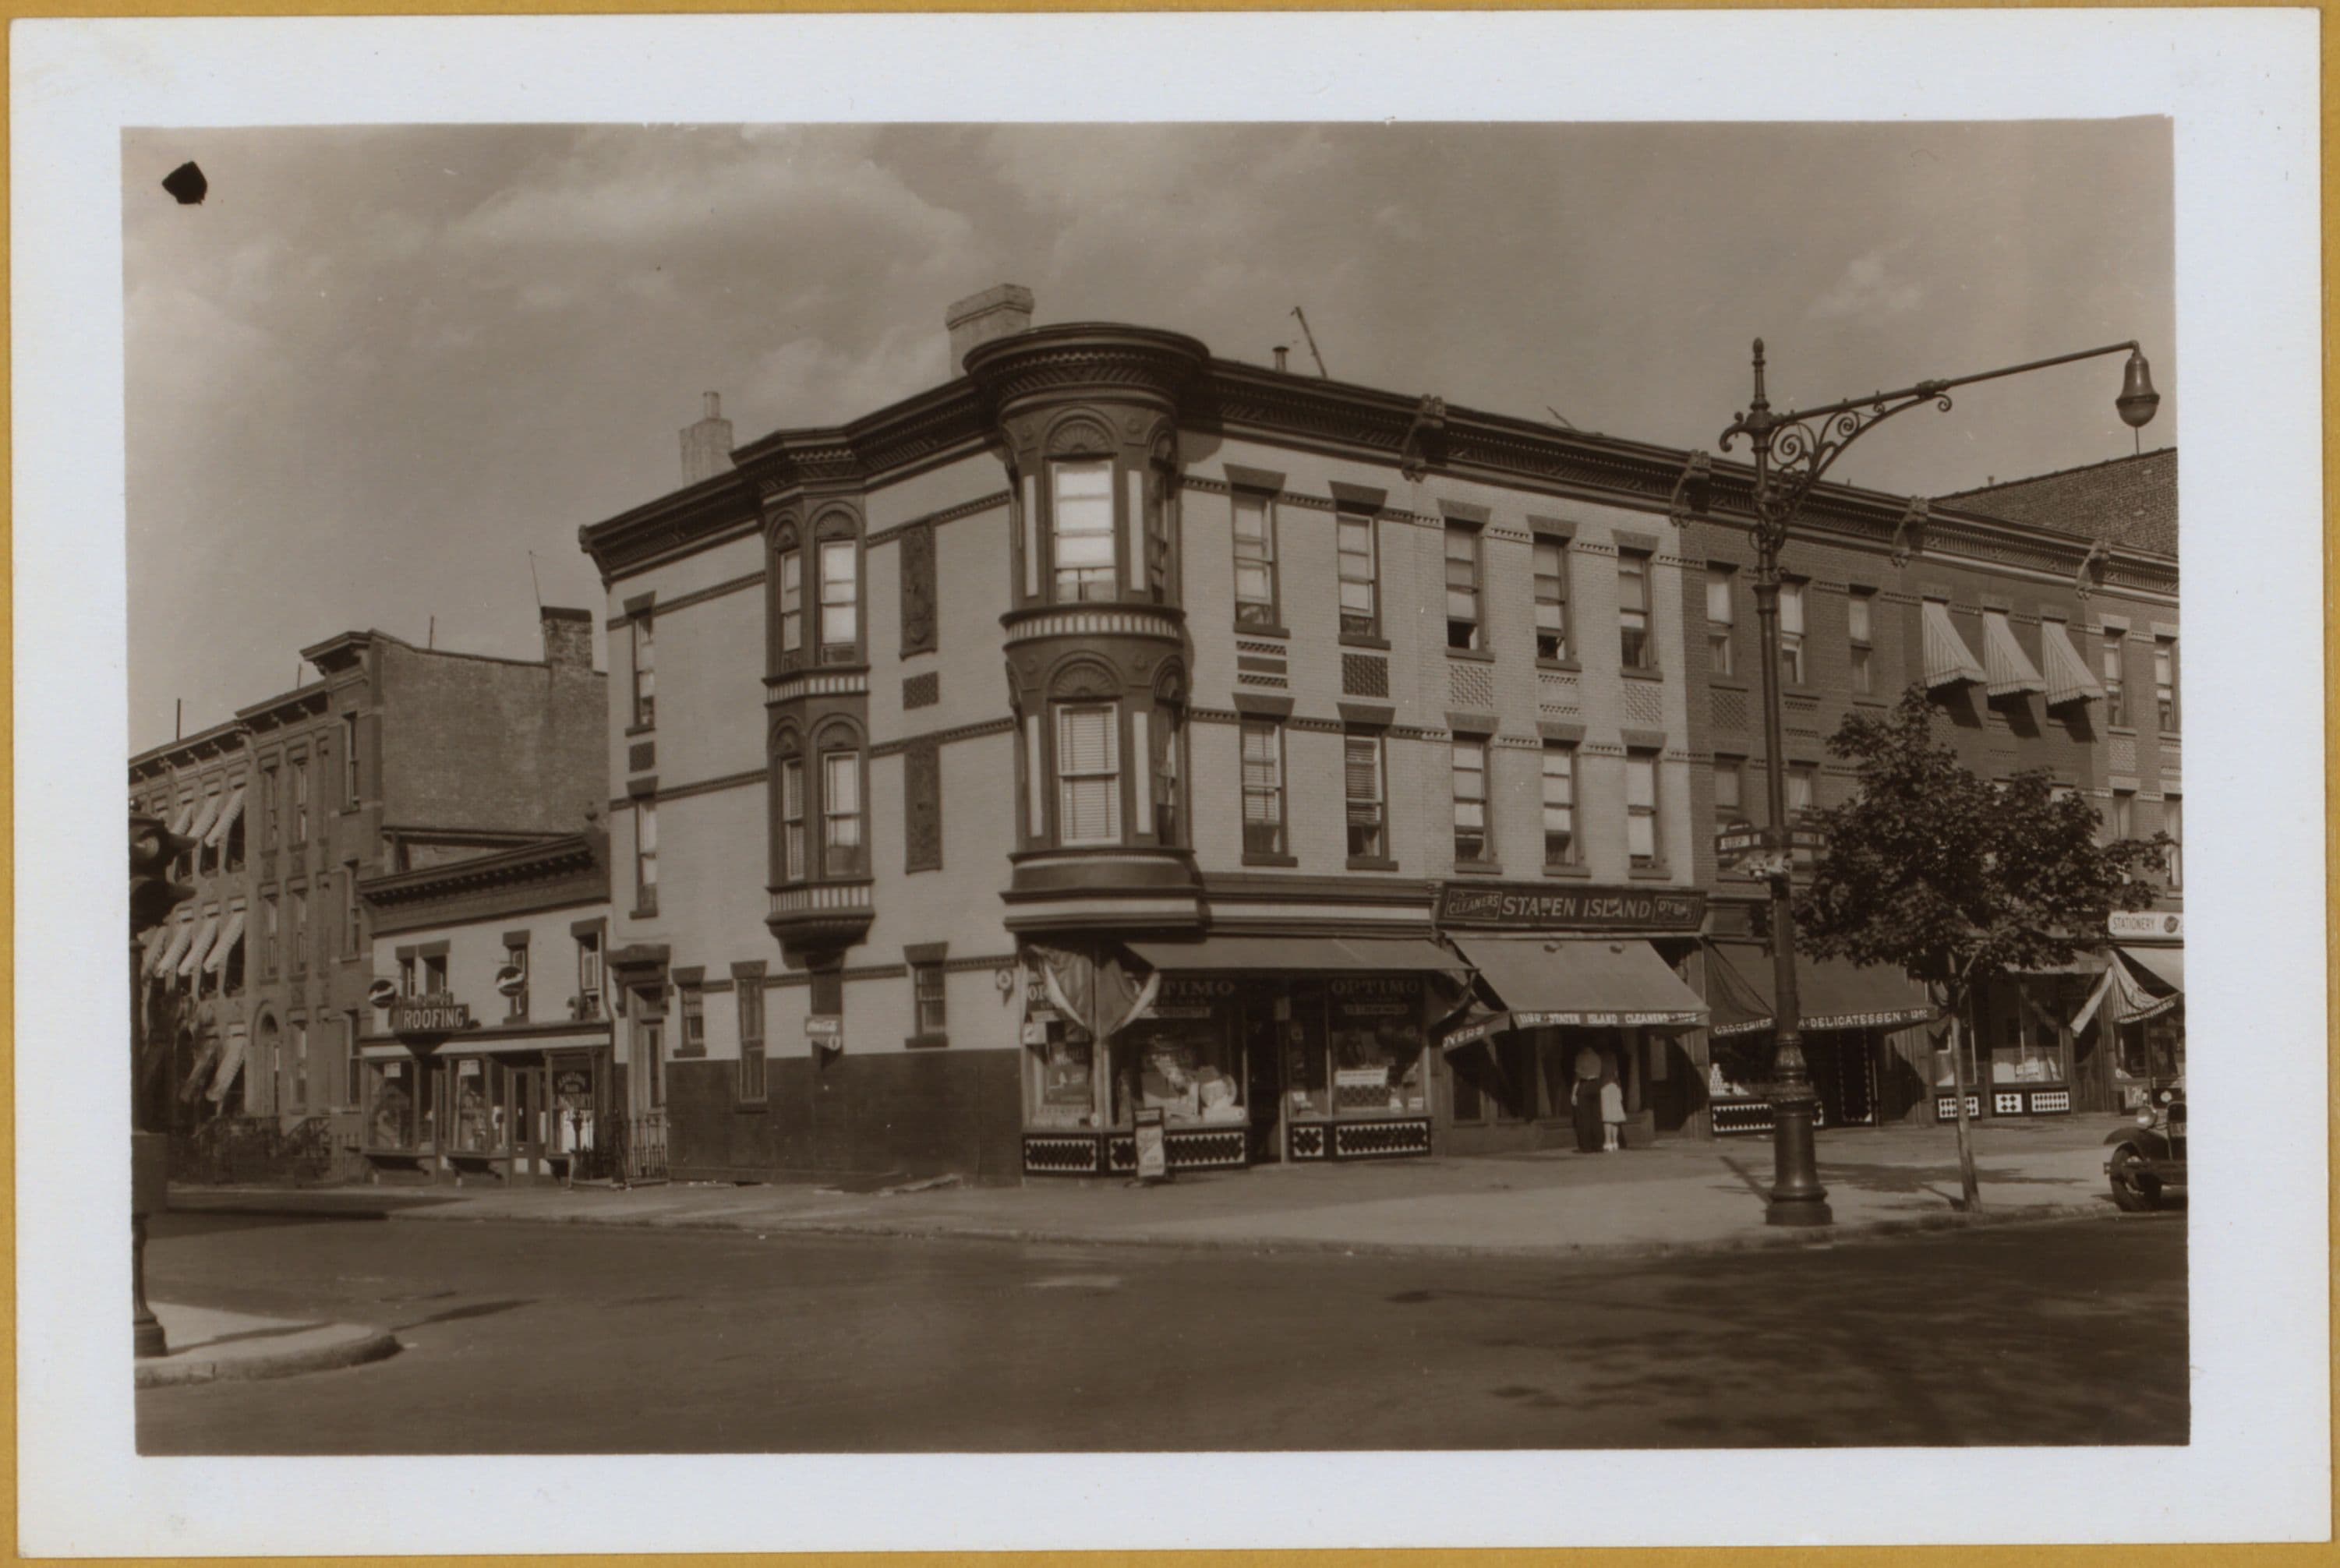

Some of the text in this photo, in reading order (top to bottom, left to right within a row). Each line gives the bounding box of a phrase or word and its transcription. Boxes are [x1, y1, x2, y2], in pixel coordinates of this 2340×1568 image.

[1583, 898, 1651, 919] ISLAND
[2112, 916, 2155, 930] STATIONERY
[1331, 979, 1419, 995] OPTIMO
[404, 1008, 463, 1029] ROOFING
[1548, 1013, 1581, 1024] STATEN
[1587, 1013, 1618, 1025] ISLAND
[1810, 1012, 1901, 1029] DELICATESSEN
[1442, 1025, 1485, 1048] DYERS
